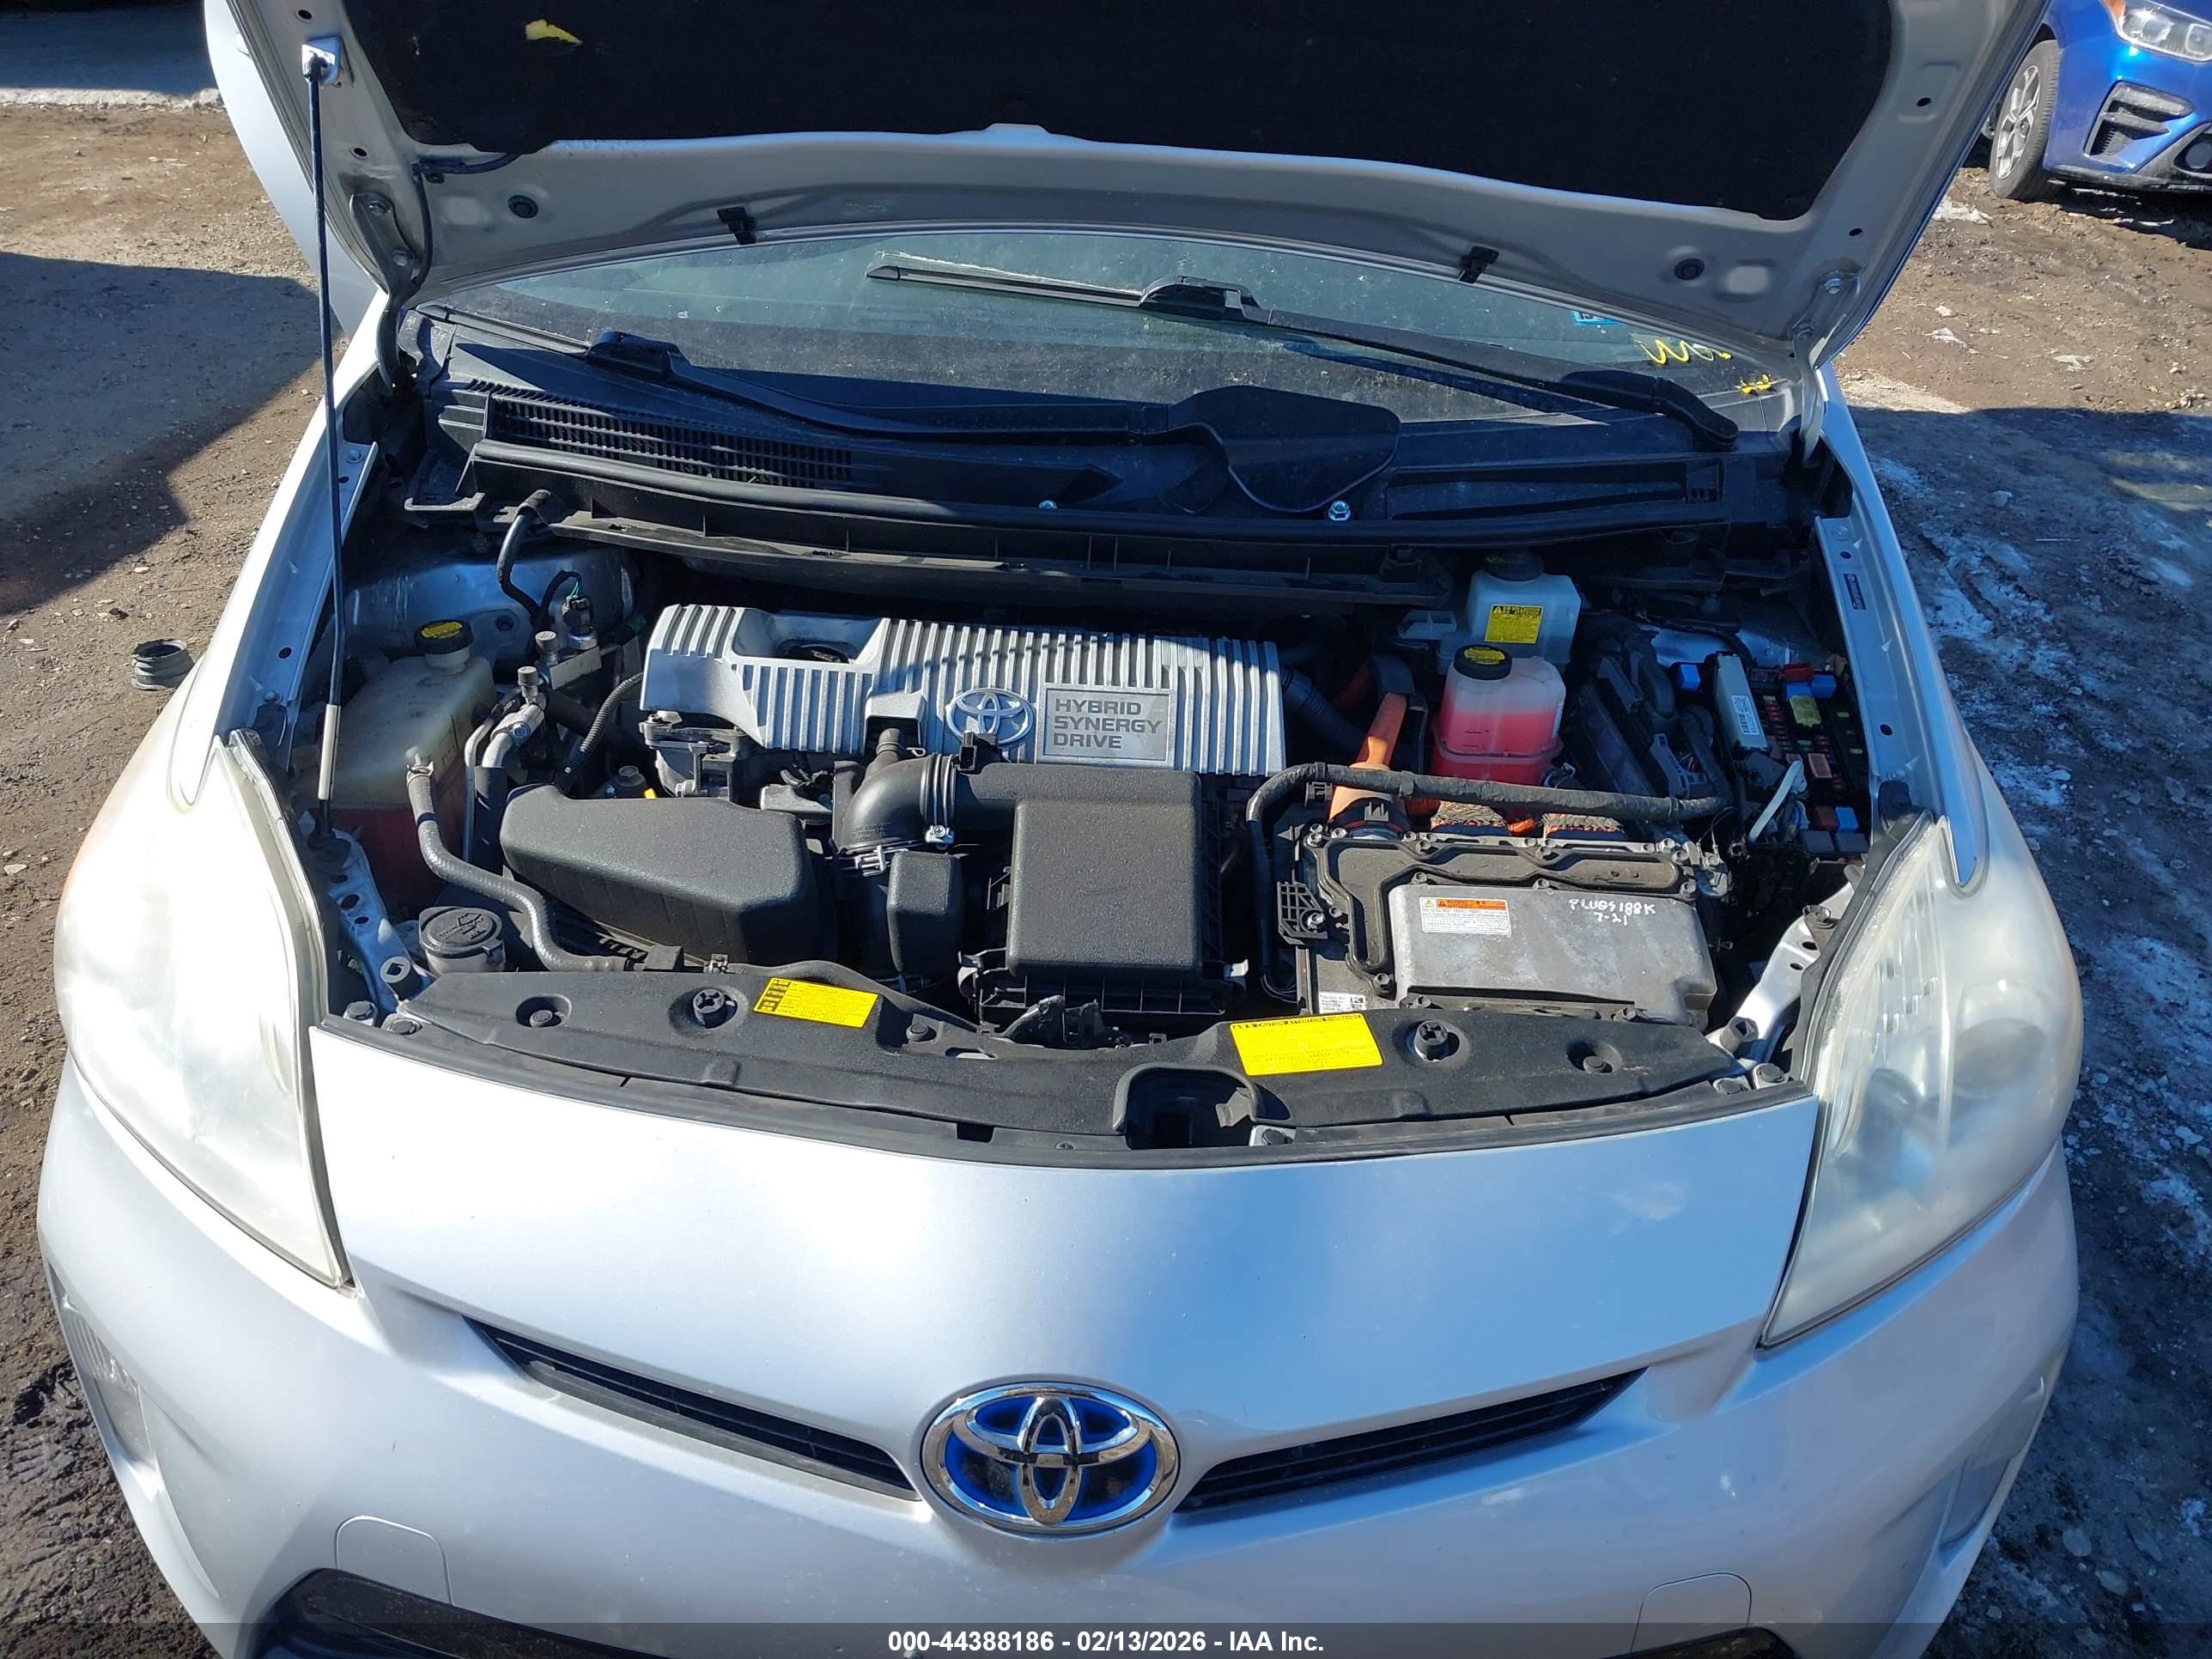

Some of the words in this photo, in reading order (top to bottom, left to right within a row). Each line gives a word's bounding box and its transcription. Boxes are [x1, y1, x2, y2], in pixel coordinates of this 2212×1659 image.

[1054, 698, 1142, 715] HYBRID
[1054, 715, 1162, 734] SYNERGY
[1053, 732, 1122, 749] DRIVE
[1569, 898, 1616, 913] PLUGS
[1619, 902, 1656, 916] 188K
[1593, 911, 1628, 927] 7-21
